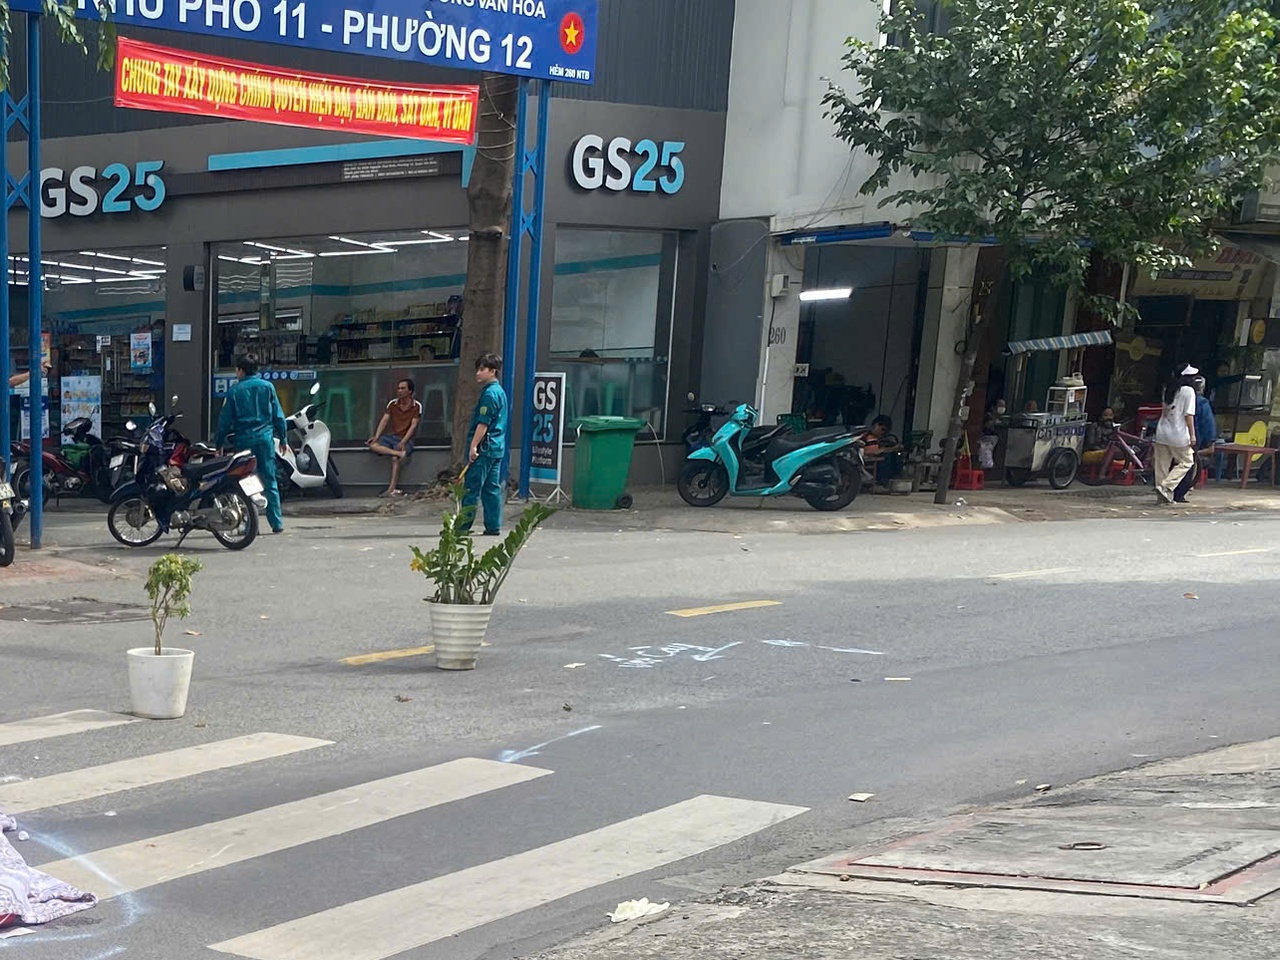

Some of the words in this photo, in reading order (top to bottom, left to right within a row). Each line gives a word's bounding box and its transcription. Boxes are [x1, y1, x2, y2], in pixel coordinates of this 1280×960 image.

[273, 0, 305, 39] 11
[343, 10, 491, 64] PHƯỜNG
[501, 33, 533, 69] 12
[122, 57, 161, 96] CHUNG
[164, 63, 182, 97] TAY
[183, 61, 205, 101] XÂY
[207, 68, 237, 110] DỰNG
[239, 69, 272, 108] CHÍNH
[40, 160, 166, 218] GS25
[573, 134, 685, 194] GS25
[769, 327, 786, 344] 260
[533, 381, 557, 411] GS
[532, 413, 555, 443] 25
